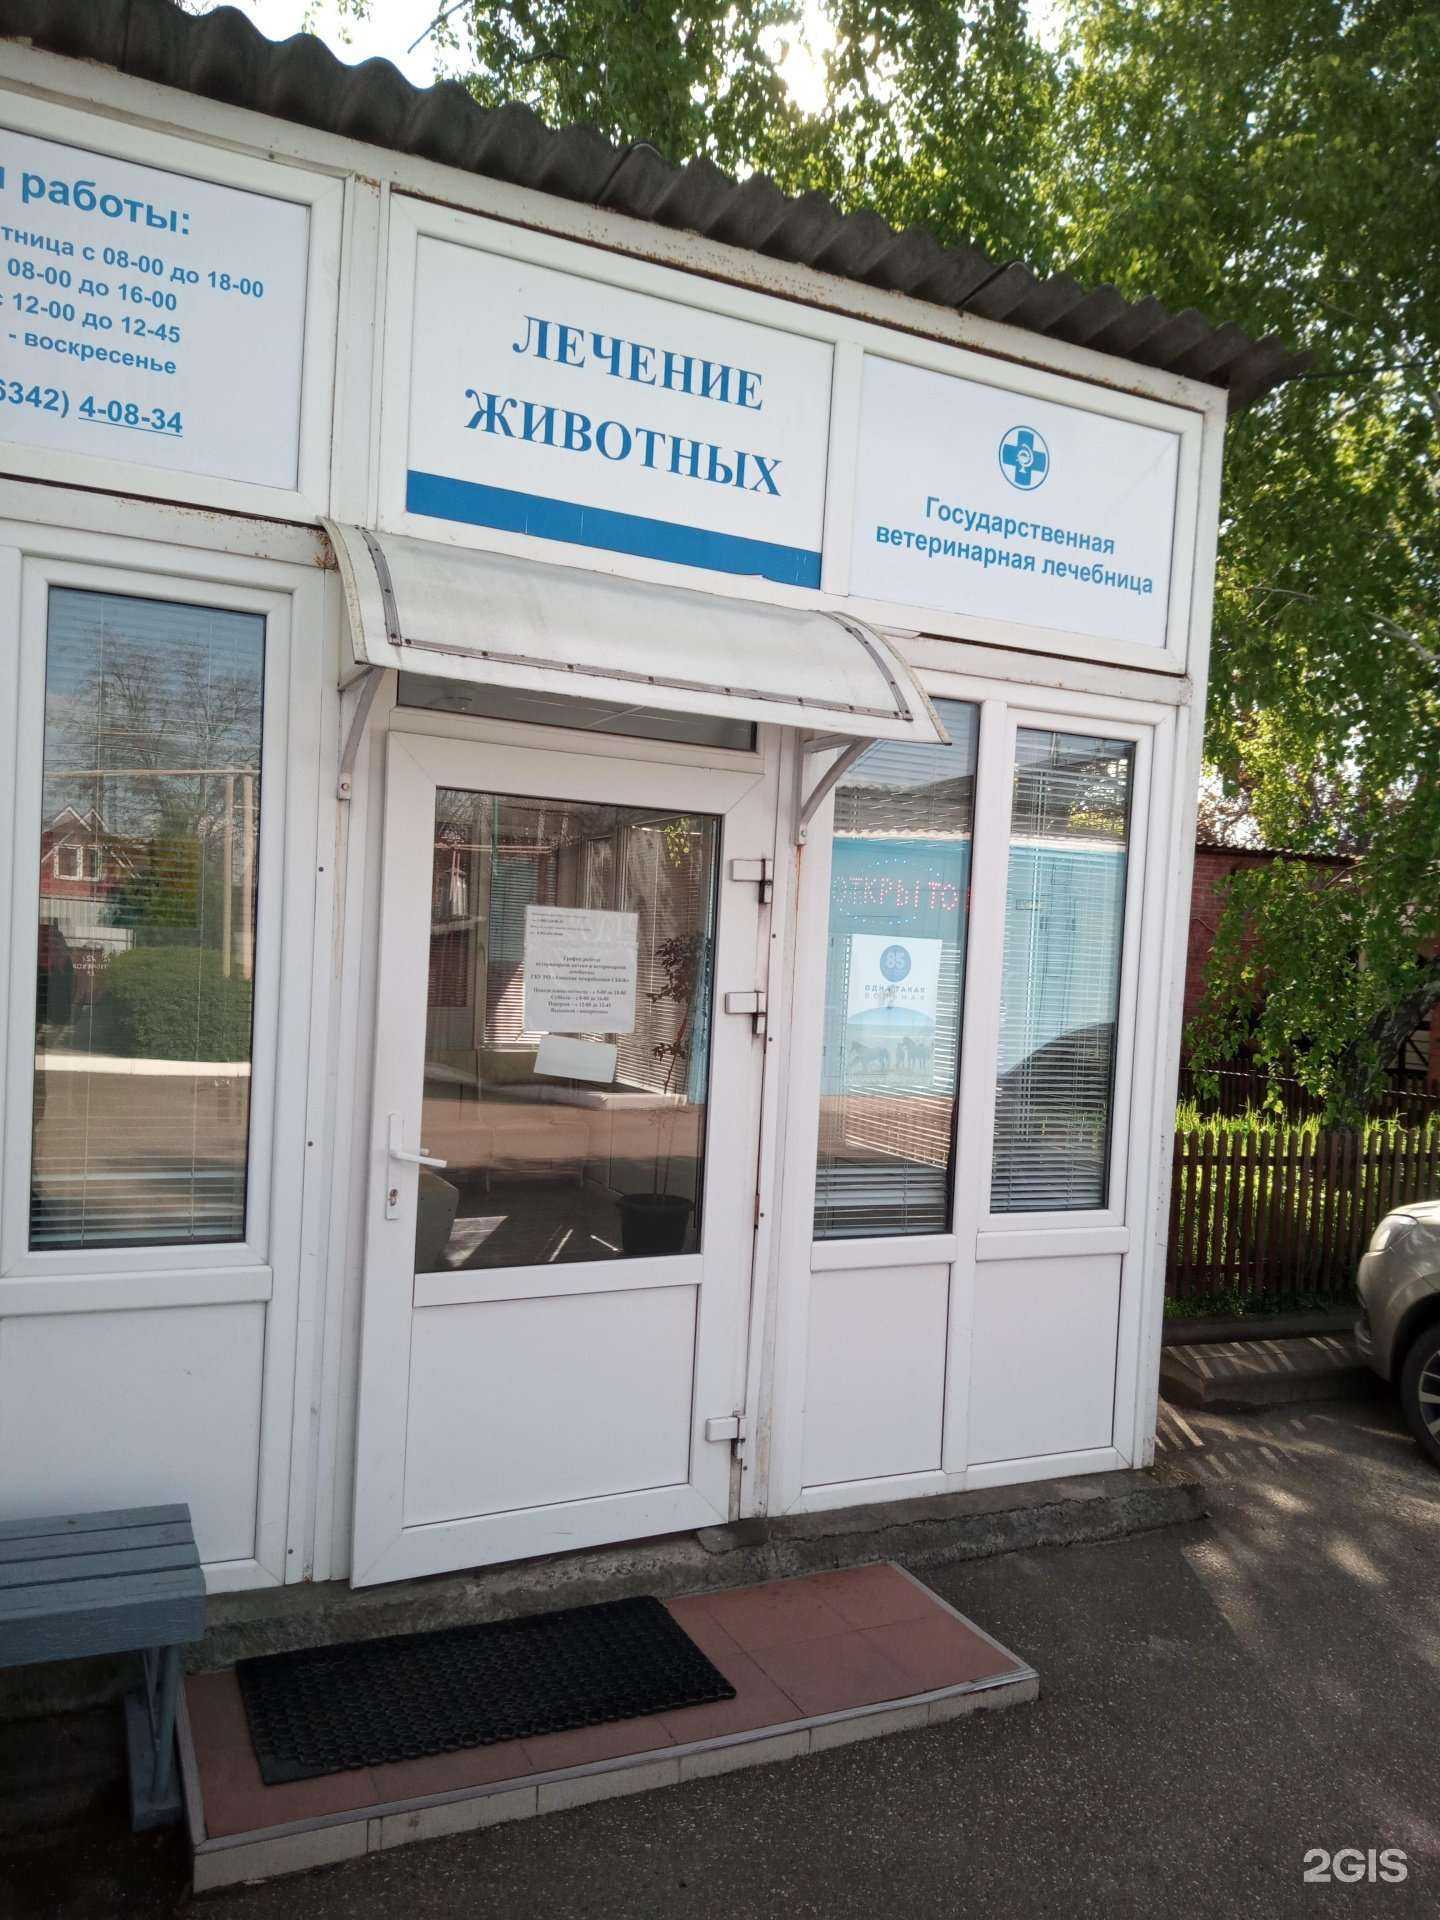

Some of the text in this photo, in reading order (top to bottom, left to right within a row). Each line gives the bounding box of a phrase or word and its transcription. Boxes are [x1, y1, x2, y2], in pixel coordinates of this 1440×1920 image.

[21, 171, 191, 236] работы:
[7, 257, 178, 312] 08-00 до 16-00
[82, 245, 96, 261] с
[103, 247, 164, 276] 08-00
[170, 266, 200, 285] до
[208, 270, 264, 299] 18-00
[13, 293, 76, 322] 12-00
[82, 311, 113, 331] до
[121, 315, 182, 344] 12-45
[24, 331, 177, 375] воскресенье
[512, 315, 763, 411] ЛЕЧЕНИЕ
[78, 394, 184, 436] 4-08-34
[464, 388, 782, 496] ЖИВОТНЫХ
[925, 495, 1115, 555] Государственная
[875, 524, 1154, 596] ветеринарная лечебница
